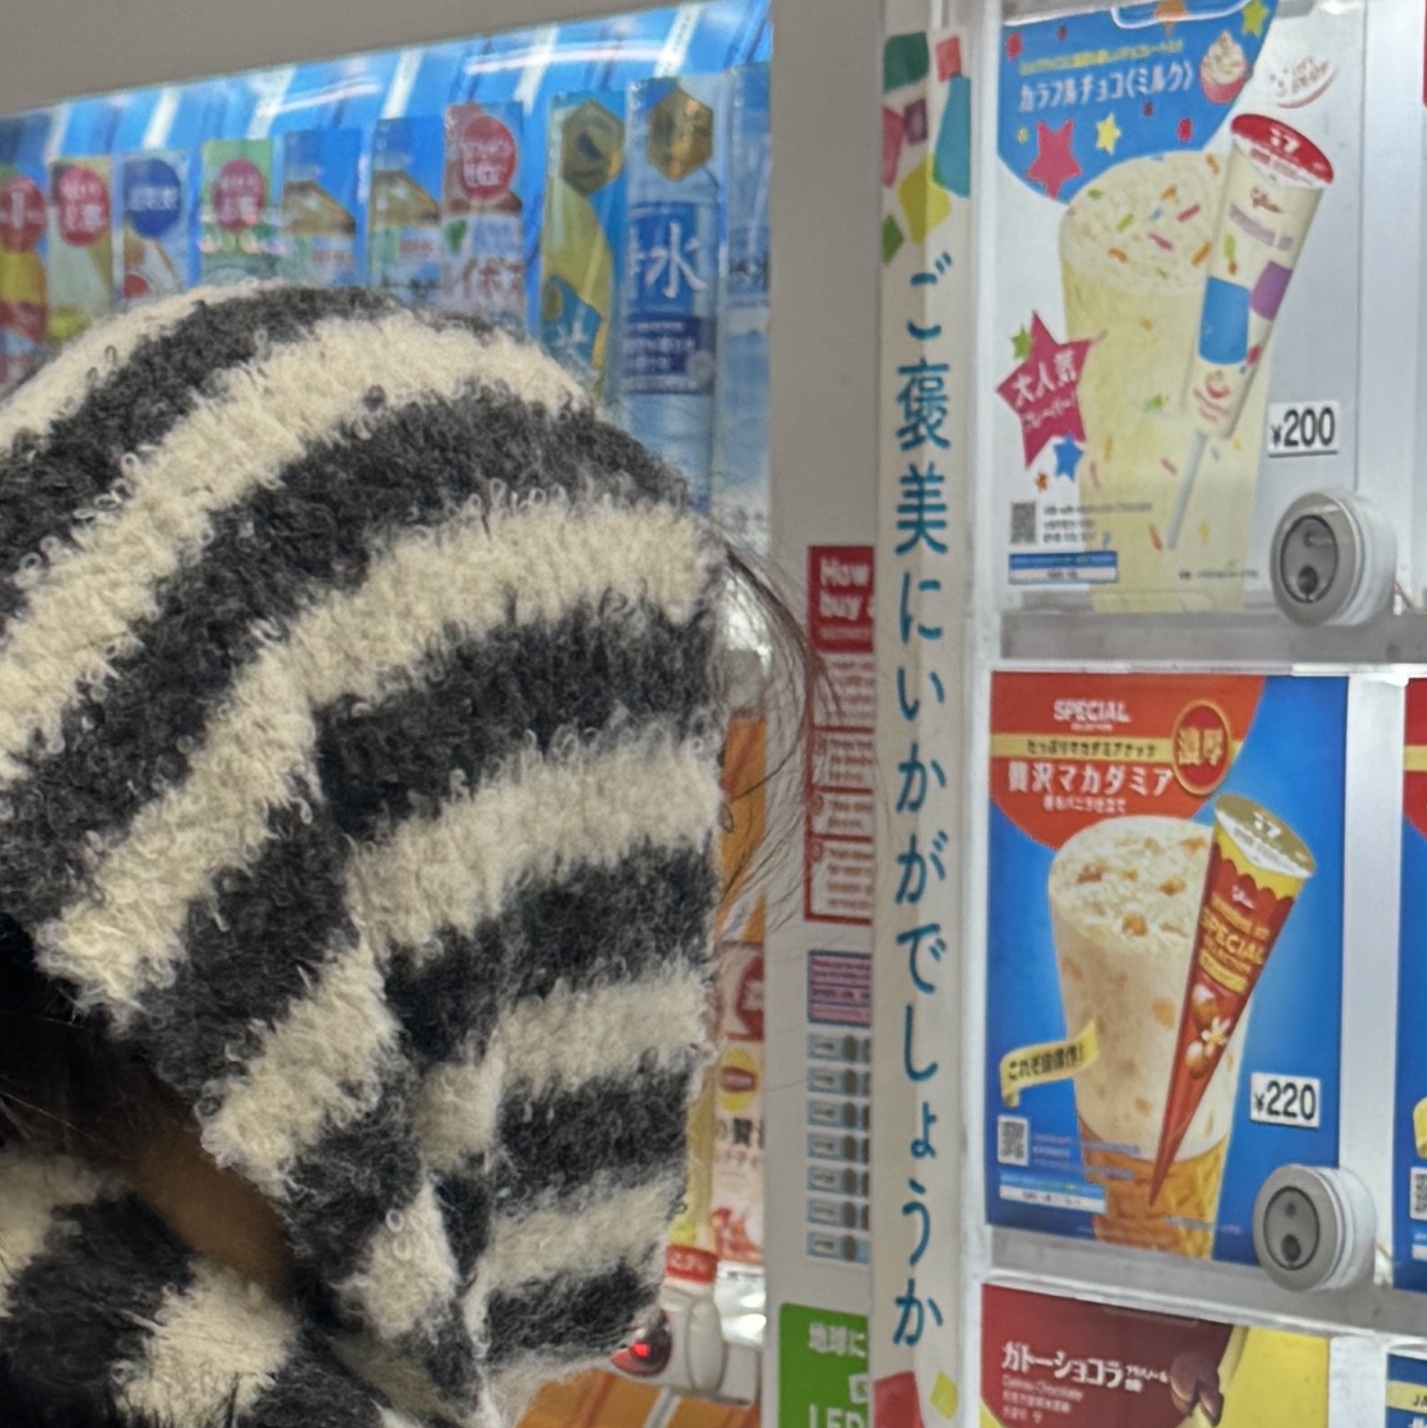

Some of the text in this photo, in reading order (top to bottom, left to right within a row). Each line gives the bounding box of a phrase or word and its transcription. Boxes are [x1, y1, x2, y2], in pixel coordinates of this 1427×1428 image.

[1271, 407, 1336, 448] ¥200
[820, 557, 869, 588] How
[1053, 699, 1132, 722] SPECIAL
[892, 250, 953, 1347] ご褒美にいかがでしょうか
[1253, 1081, 1316, 1121] ¥220
[1001, 1341, 1124, 1389] ガトーショコラ
